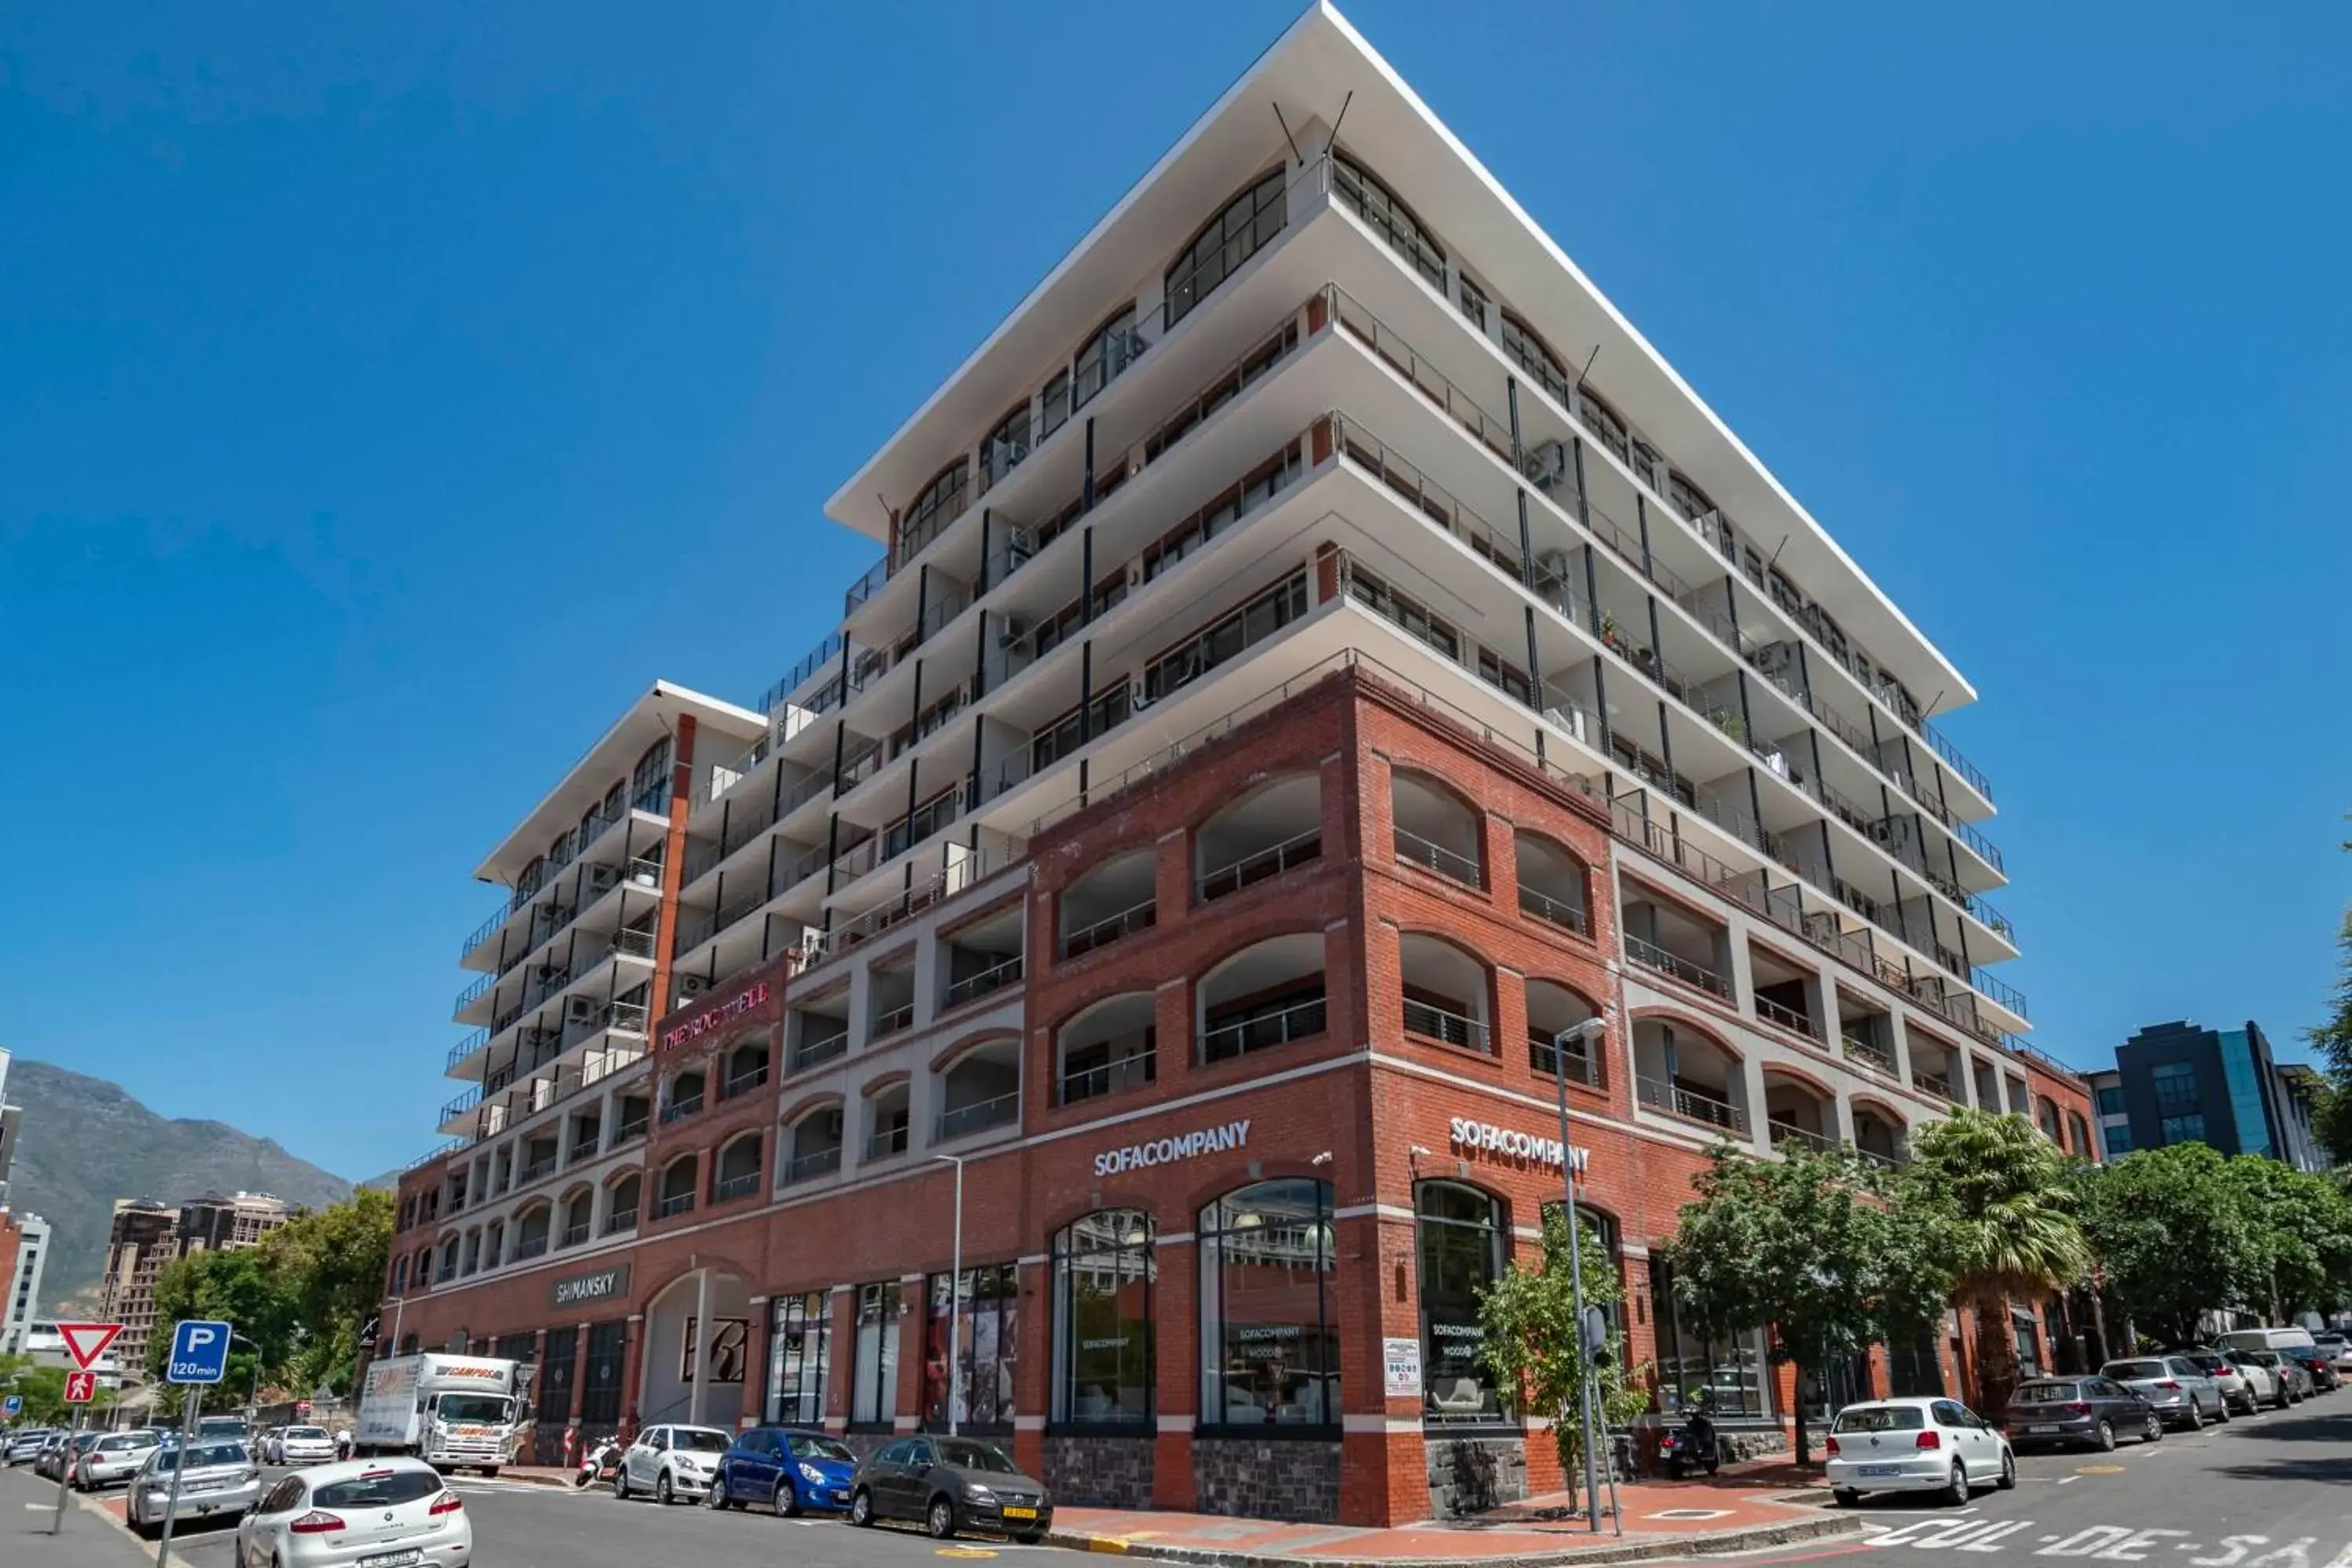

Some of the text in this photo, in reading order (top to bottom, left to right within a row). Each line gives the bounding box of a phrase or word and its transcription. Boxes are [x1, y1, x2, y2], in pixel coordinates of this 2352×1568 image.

[664, 982, 770, 1051] THE ROCWELL
[1094, 1120, 1250, 1176] SOFACOMPANY
[1450, 1116, 1591, 1171] SOFACOMPANY
[557, 1272, 615, 1303] SHIMANSKY
[187, 1328, 216, 1353] P
[1240, 1326, 1300, 1340] SOFACOMPANY
[1433, 1323, 1484, 1337] SOFACOMPAN
